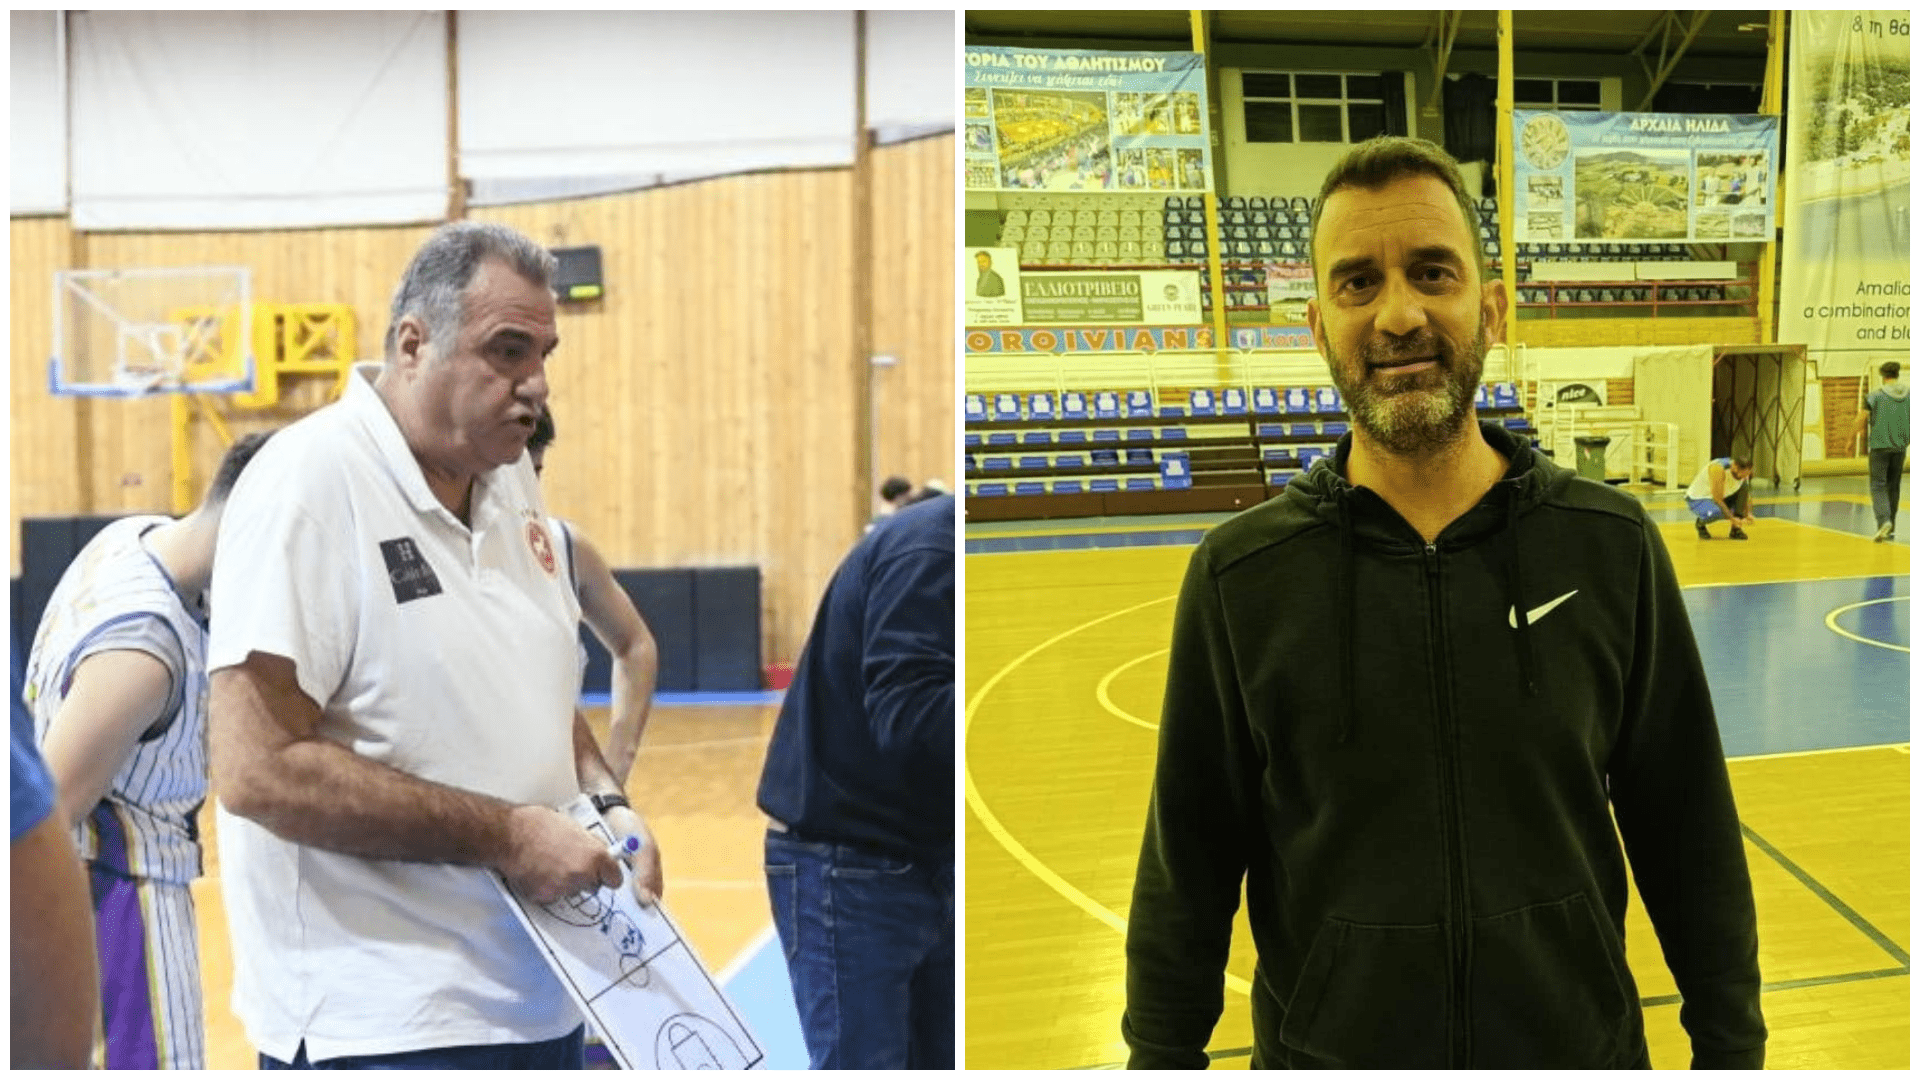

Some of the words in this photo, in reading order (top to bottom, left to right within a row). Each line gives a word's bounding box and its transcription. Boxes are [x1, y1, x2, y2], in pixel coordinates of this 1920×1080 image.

[1853, 15, 1863, 33] &
[1013, 54, 1048, 69] ΤΟΥ
[1053, 56, 1166, 72] ΑΘΛΗΤΙΣΜΟΥ
[1803, 306, 1814, 319] a
[1856, 325, 1887, 340] and
